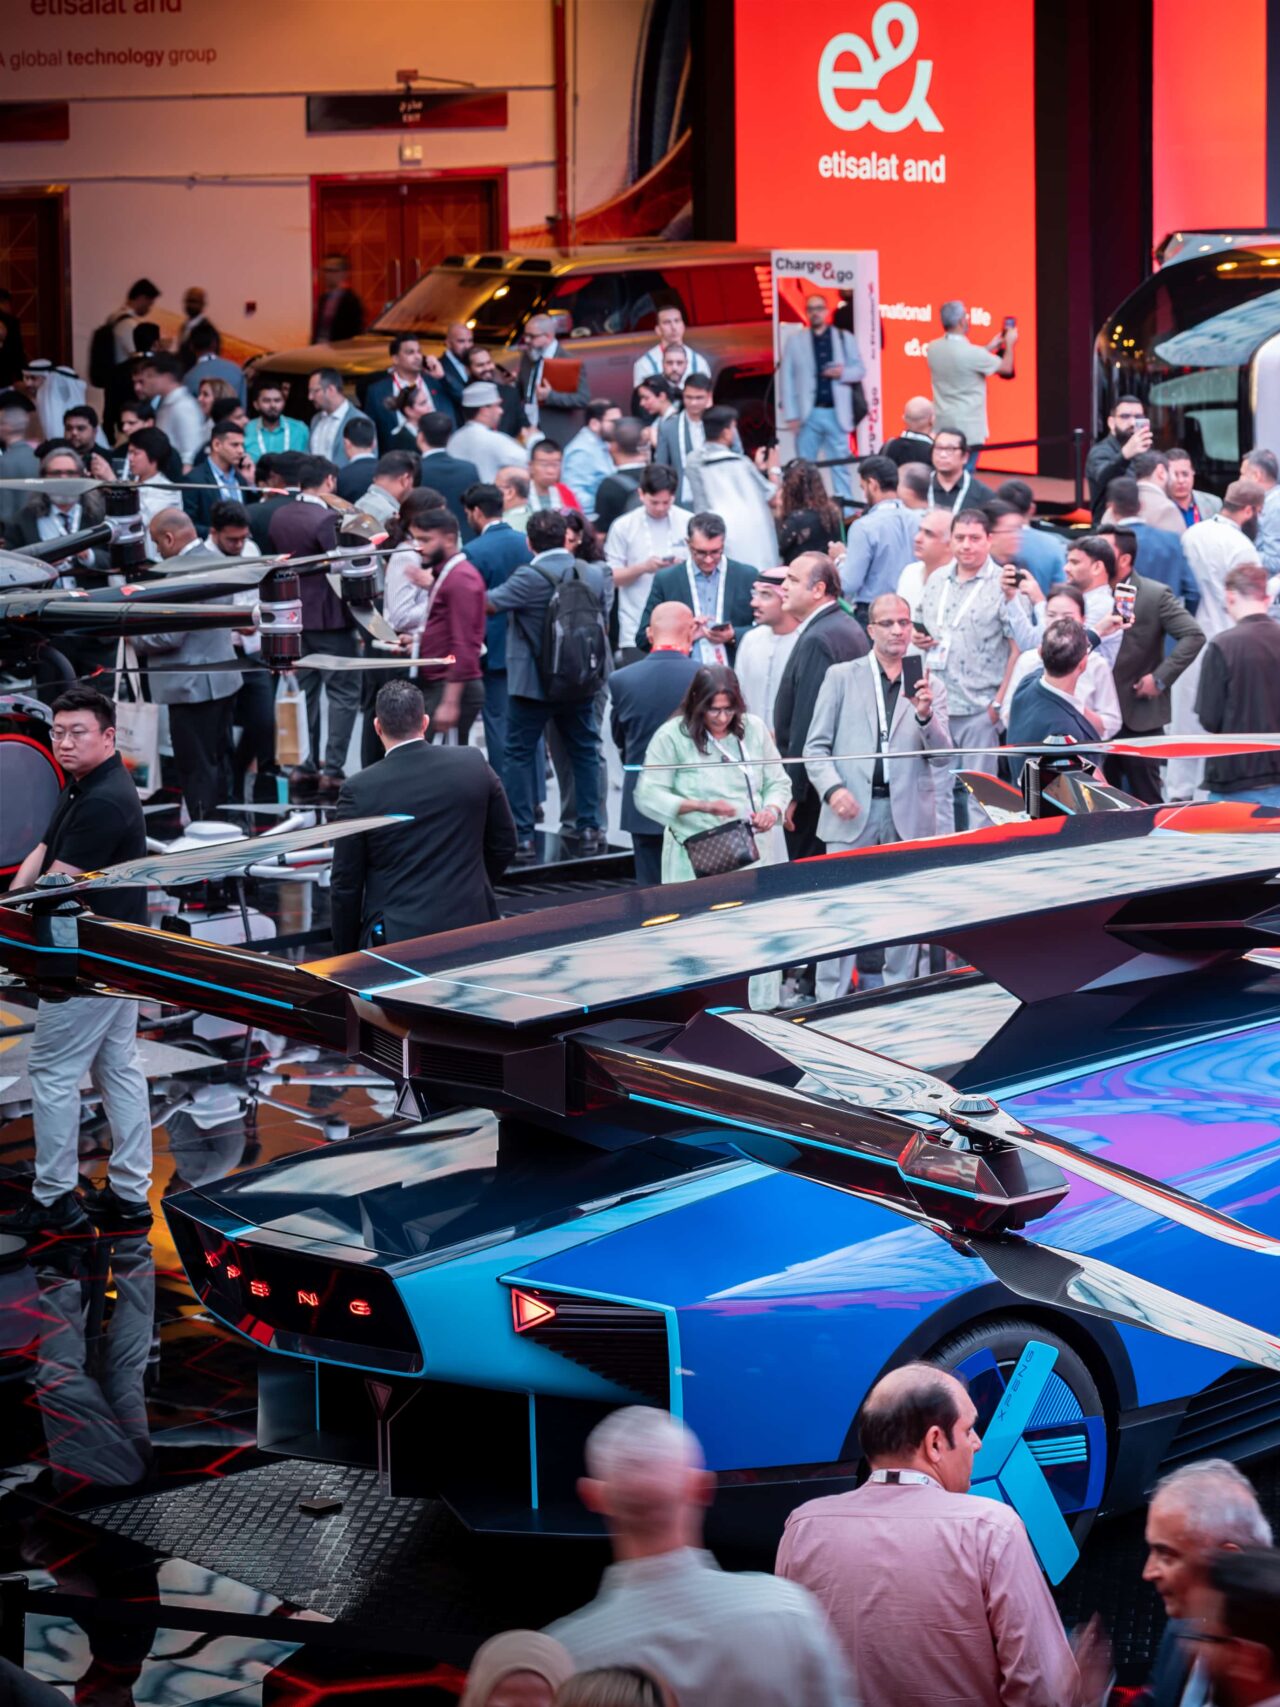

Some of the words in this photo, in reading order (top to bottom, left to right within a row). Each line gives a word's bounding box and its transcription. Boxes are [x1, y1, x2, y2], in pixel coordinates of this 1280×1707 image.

[9, 49, 63, 71] global
[67, 48, 165, 68] technology
[168, 47, 217, 66] group
[818, 150, 899, 182] etisalat
[903, 154, 946, 184] and
